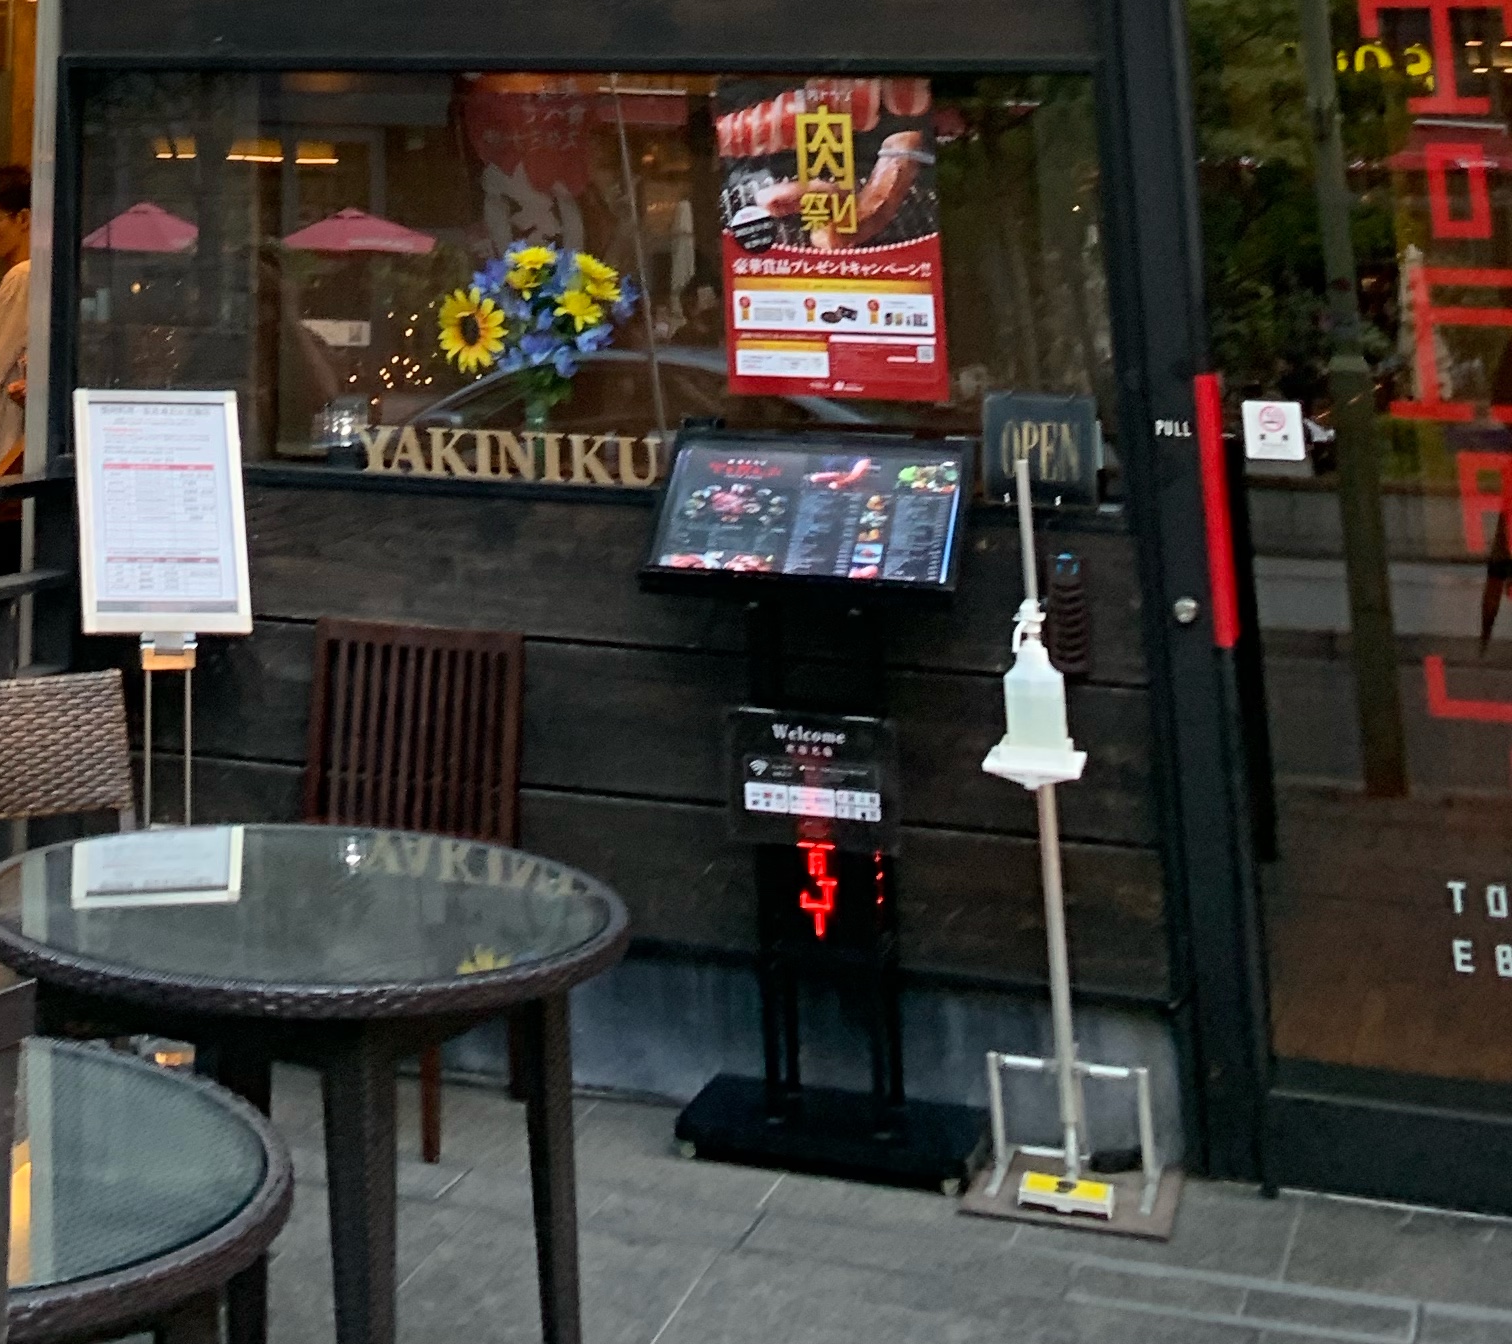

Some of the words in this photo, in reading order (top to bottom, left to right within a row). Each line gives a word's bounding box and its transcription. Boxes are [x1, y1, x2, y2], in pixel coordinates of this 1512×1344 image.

[795, 104, 855, 189] 肉
[354, 424, 665, 489] YAKINIKU
[1002, 419, 1080, 482] OPEN
[1154, 419, 1192, 437] PULL
[771, 723, 847, 745] Welcome
